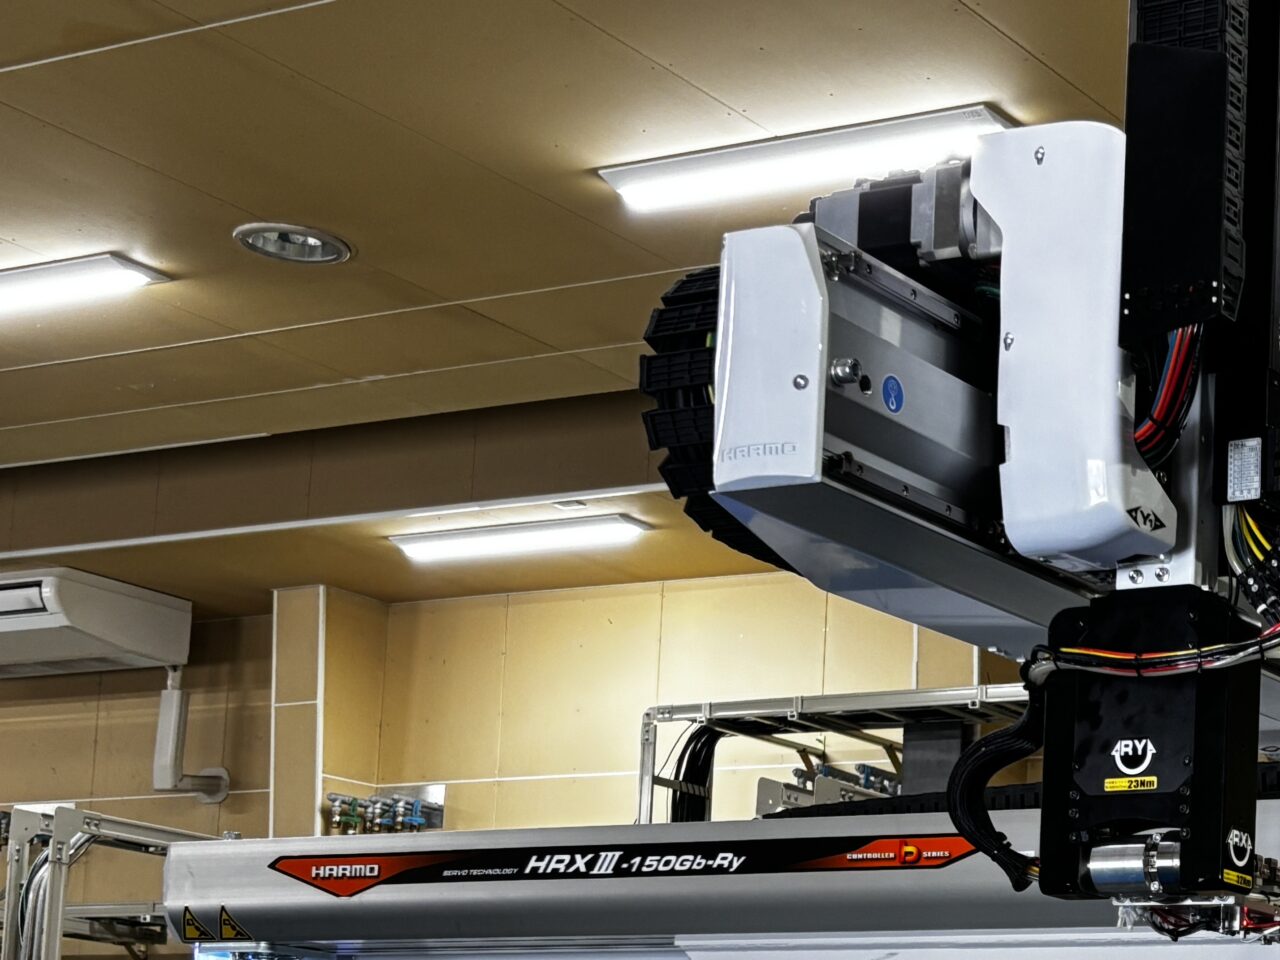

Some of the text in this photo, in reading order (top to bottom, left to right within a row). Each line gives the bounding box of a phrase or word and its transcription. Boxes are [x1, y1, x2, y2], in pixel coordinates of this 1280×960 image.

[721, 443, 797, 462] HARMO
[1120, 739, 1147, 756] RY
[1127, 779, 1155, 789] 23Nm
[1232, 829, 1248, 848] RX
[846, 852, 895, 860] CONTROLLER
[922, 850, 950, 858] SERIES
[311, 864, 379, 879] HARMO
[469, 867, 519, 876] TECHNOLOGY
